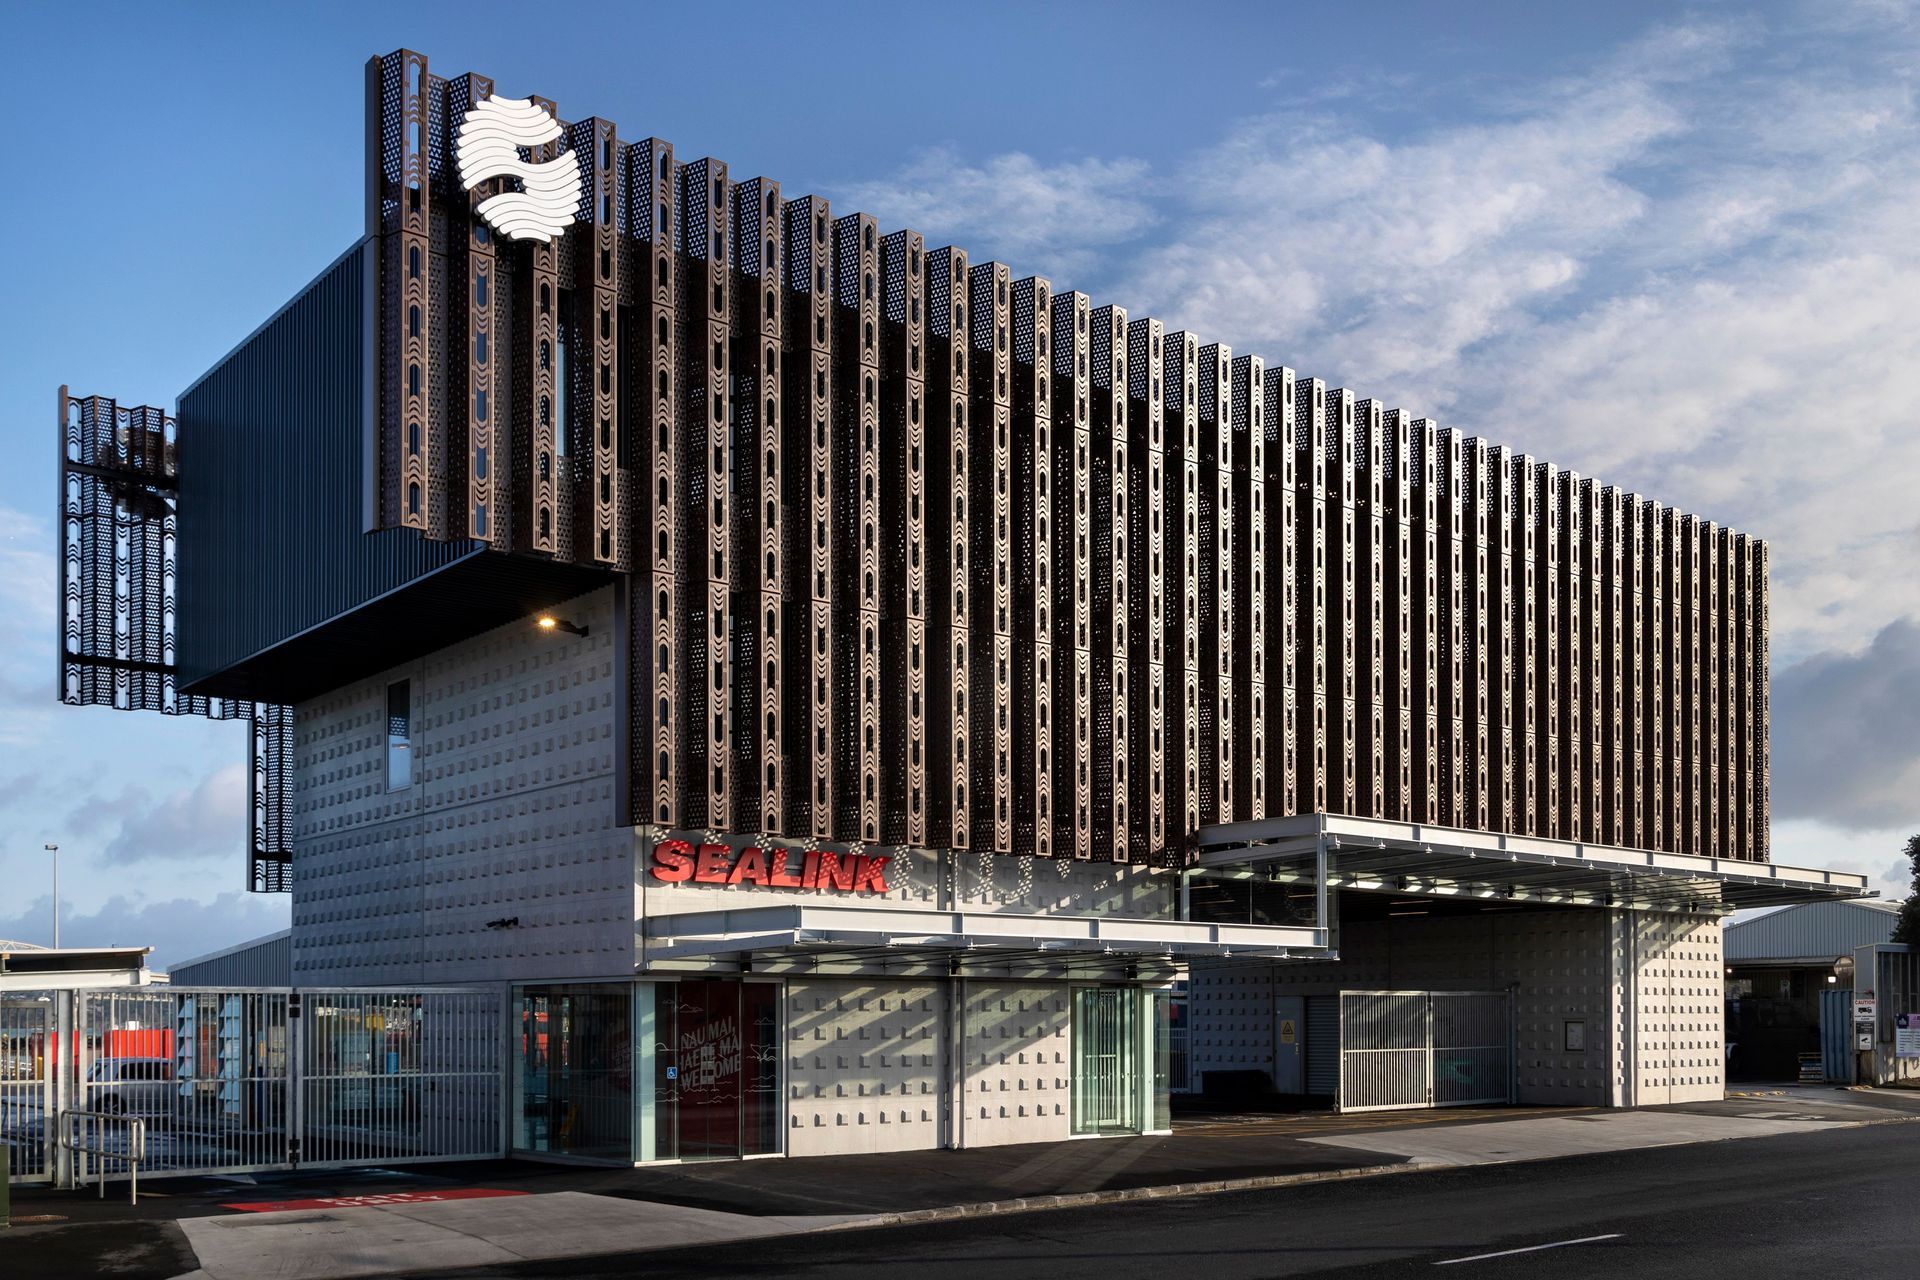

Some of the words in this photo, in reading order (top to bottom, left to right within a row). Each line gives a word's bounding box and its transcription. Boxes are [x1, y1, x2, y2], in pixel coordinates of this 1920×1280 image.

[651, 839, 892, 892] SEALINK
[681, 1026, 705, 1052] NAU
[315, 1193, 413, 1203] EXIT
[335, 1195, 445, 1206] ONLY
